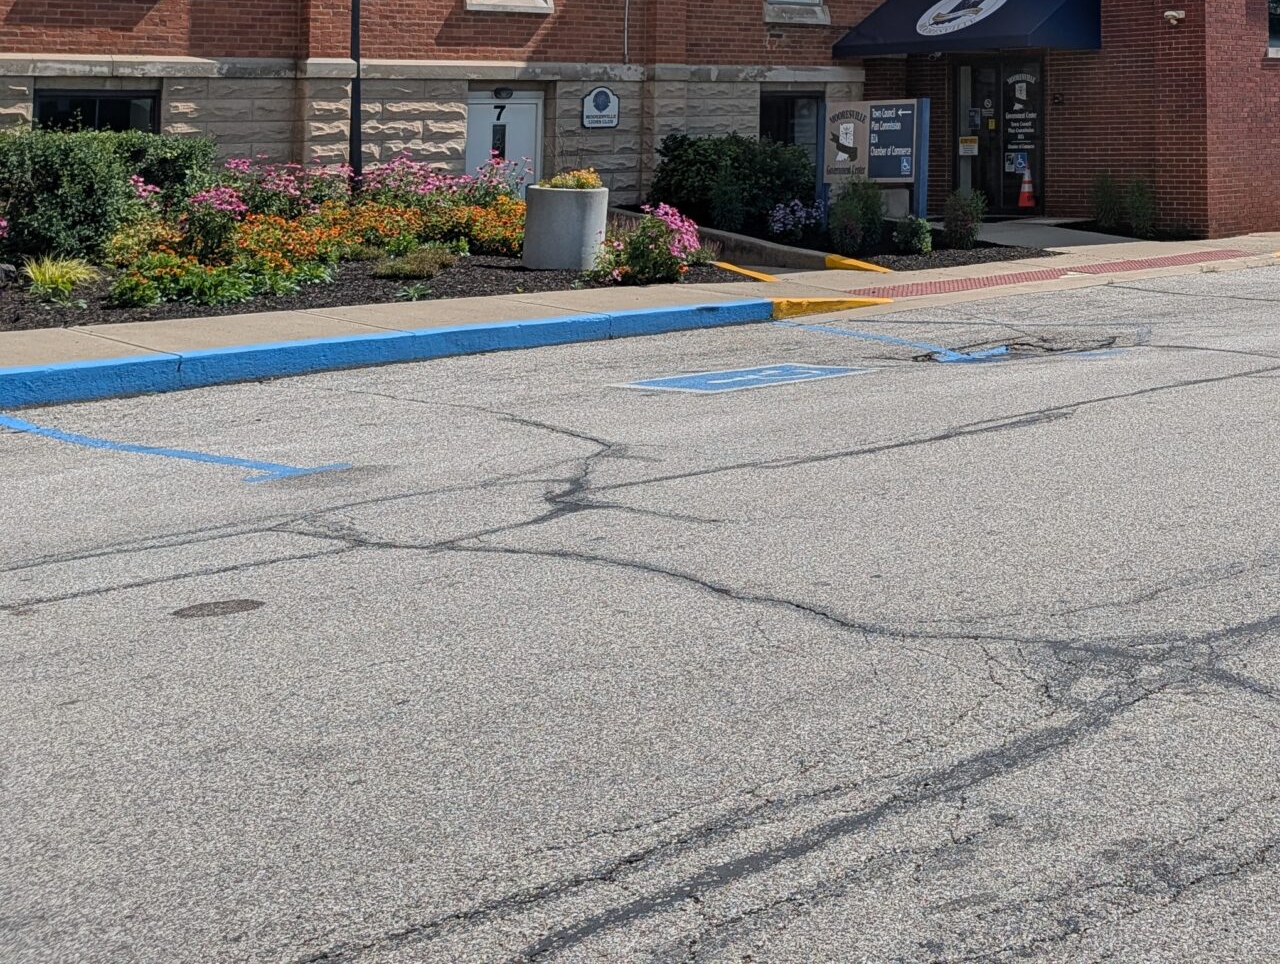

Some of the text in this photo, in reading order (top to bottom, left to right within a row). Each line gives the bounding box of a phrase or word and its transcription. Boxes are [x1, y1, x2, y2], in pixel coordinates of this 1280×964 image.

[493, 105, 506, 121] 7
[829, 110, 867, 124] MOORESVILLE
[872, 108, 896, 118] Town Council
[871, 121, 901, 131] Plan Commission
[870, 146, 911, 156] Chamber of Commerce
